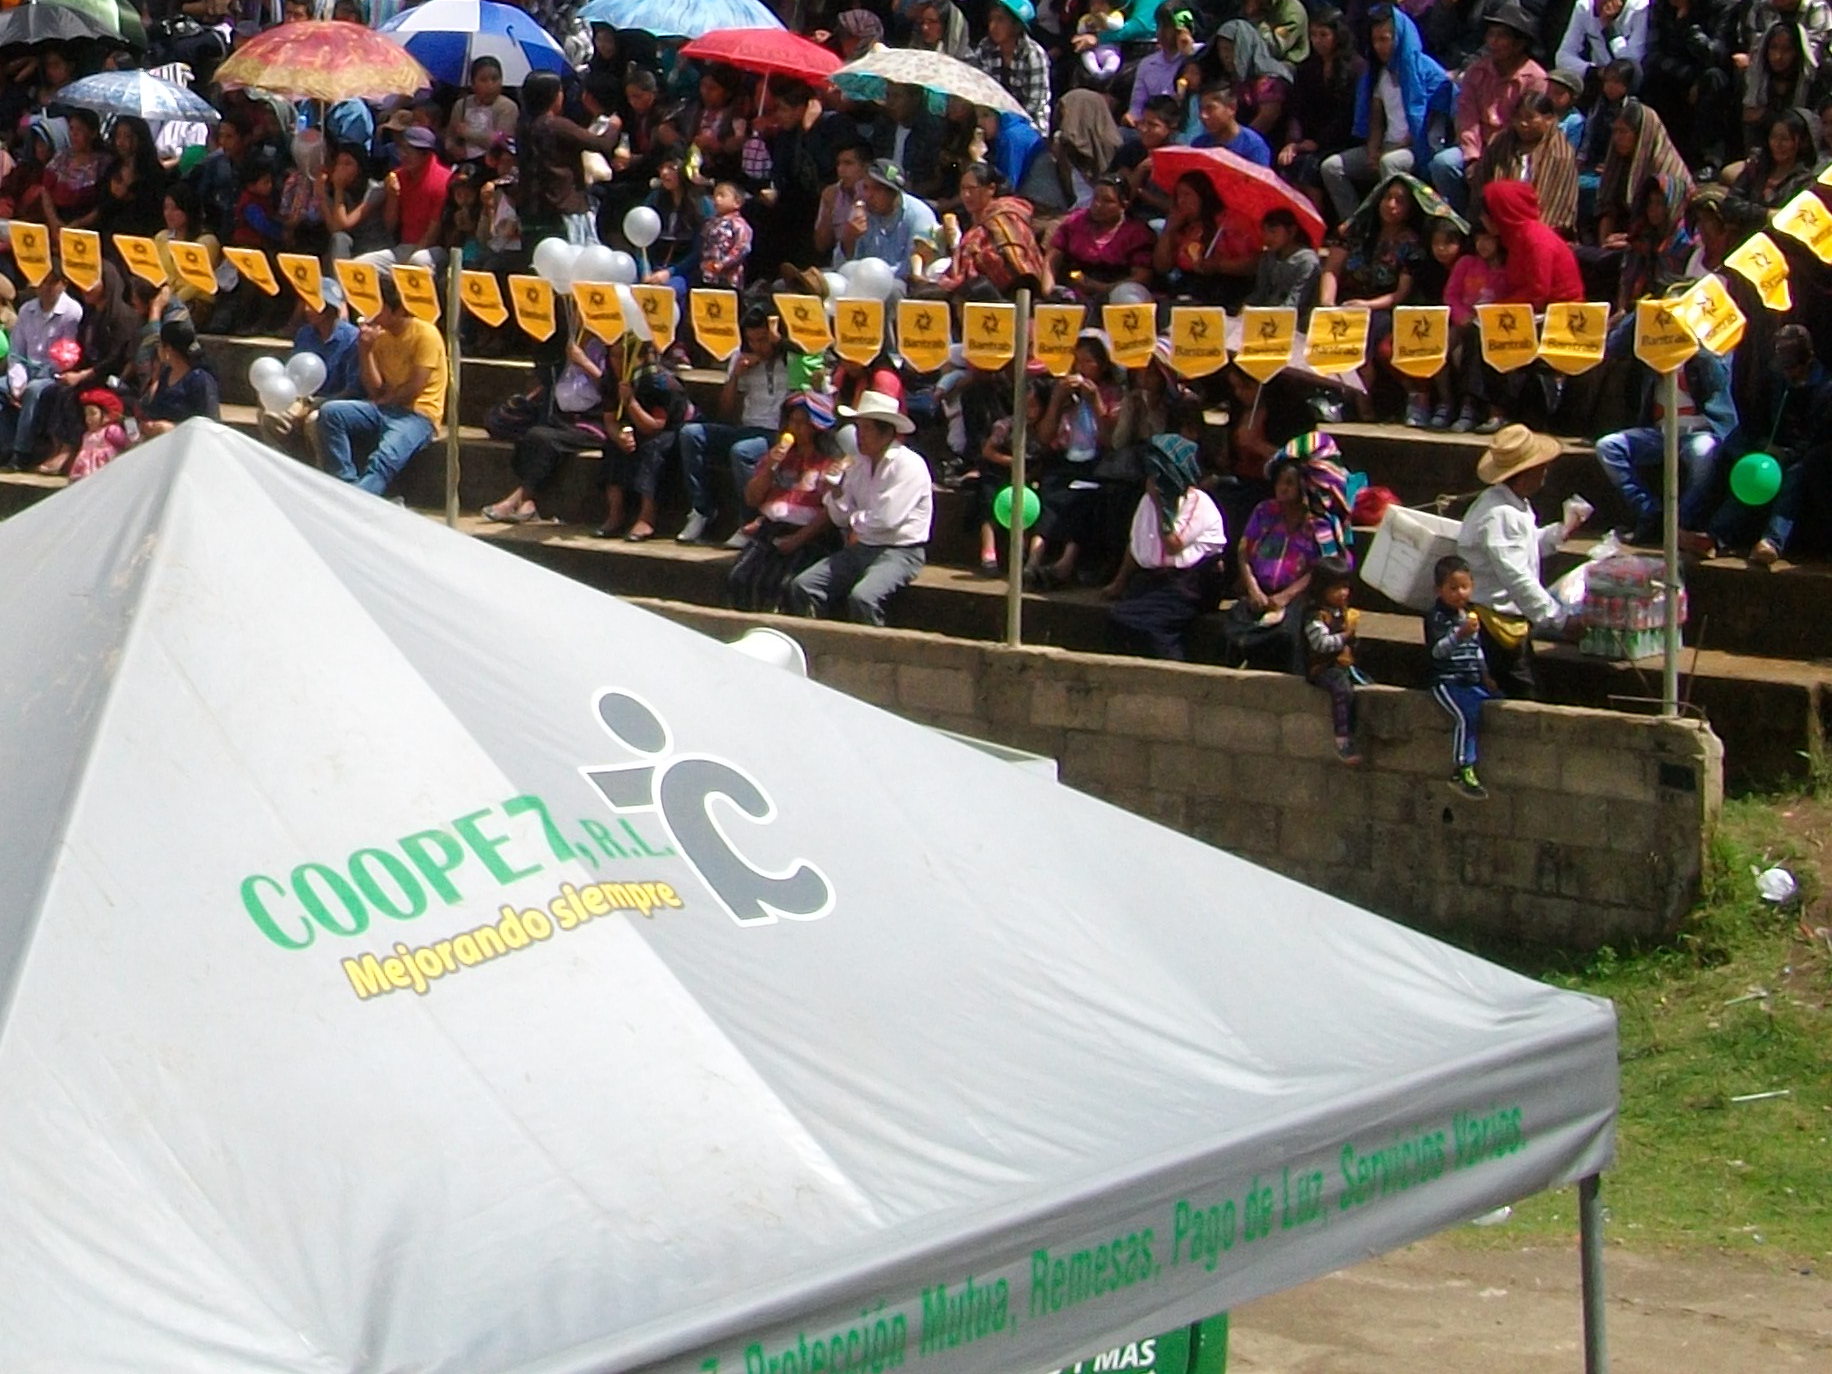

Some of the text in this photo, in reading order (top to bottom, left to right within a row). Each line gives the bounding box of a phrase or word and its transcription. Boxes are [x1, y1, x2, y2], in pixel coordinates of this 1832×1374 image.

[342, 879, 684, 1001] Mejorando siempre
[1029, 1226, 1162, 1319] Remesas,
[1171, 1197, 1237, 1273] Pago
[1244, 1175, 1274, 1243] de
[1339, 1123, 1447, 1212] Servicios
